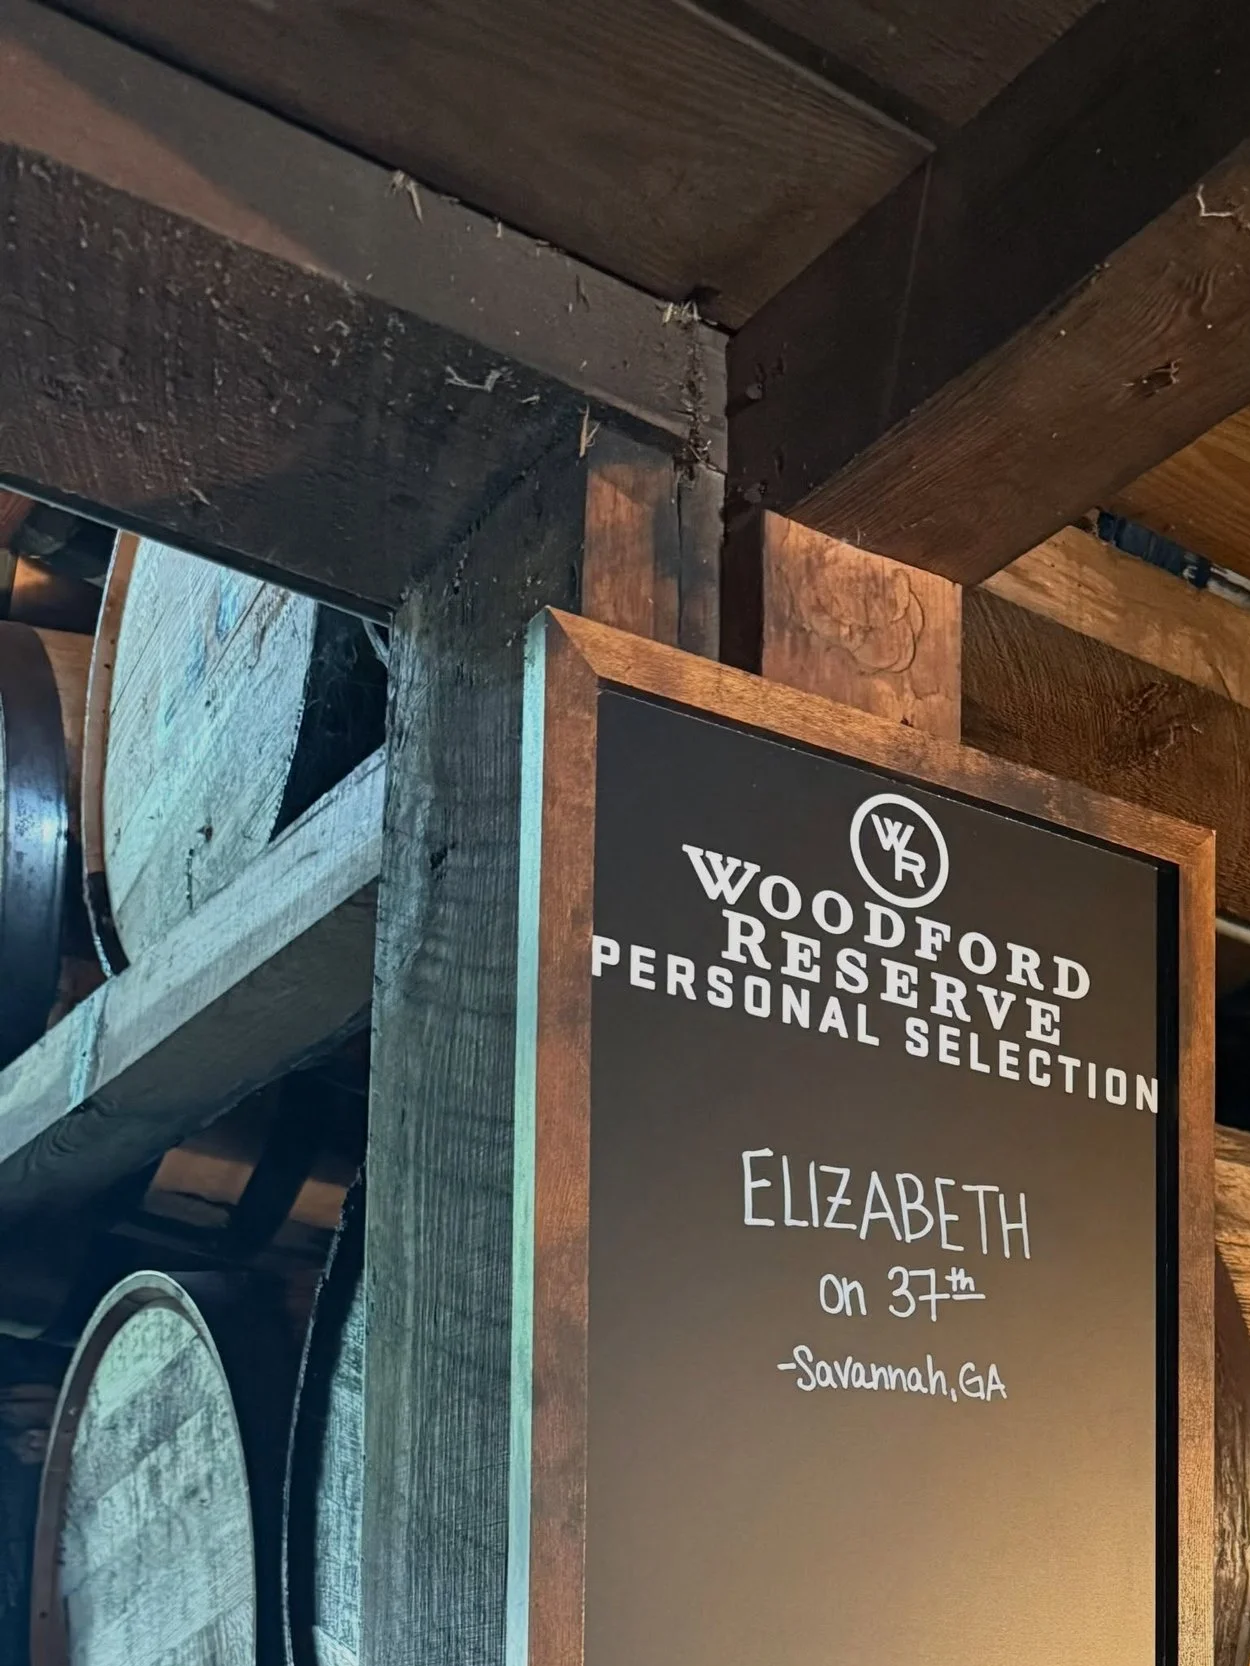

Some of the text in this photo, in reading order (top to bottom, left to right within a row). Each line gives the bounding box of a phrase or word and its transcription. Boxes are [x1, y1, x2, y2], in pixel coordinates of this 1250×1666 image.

[682, 844, 1091, 1000] WOODFORD
[721, 909, 1062, 1047] RESERVE
[592, 935, 1159, 1114] PERSONAL SELECTION
[742, 1147, 1031, 1260] ELIZABETH
